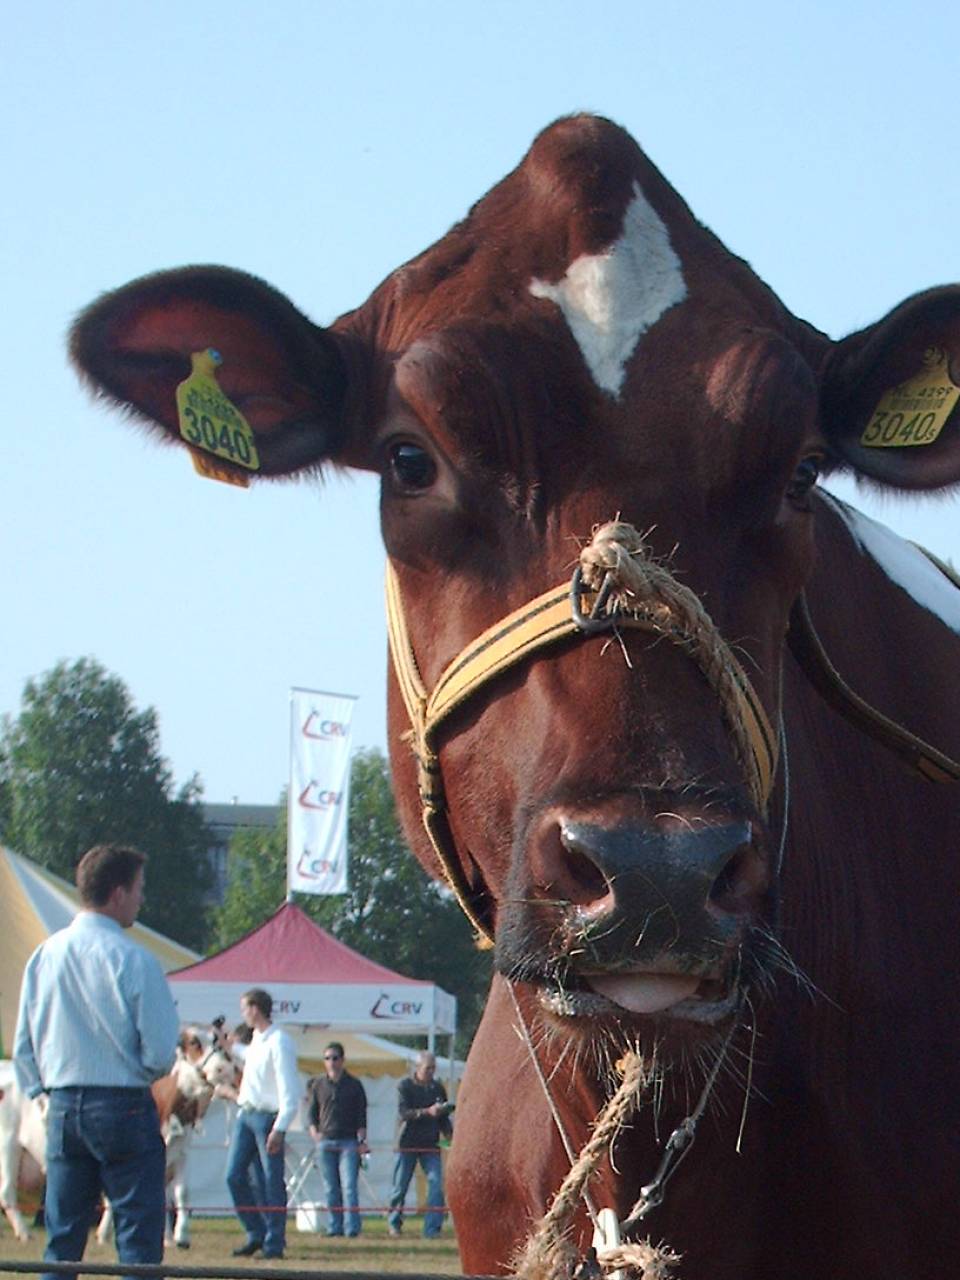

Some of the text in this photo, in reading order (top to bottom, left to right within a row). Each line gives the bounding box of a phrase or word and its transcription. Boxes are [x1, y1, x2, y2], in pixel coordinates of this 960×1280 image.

[183, 407, 251, 464] 3040
[864, 411, 936, 442] 3040
[391, 1001, 423, 1015] CRV
